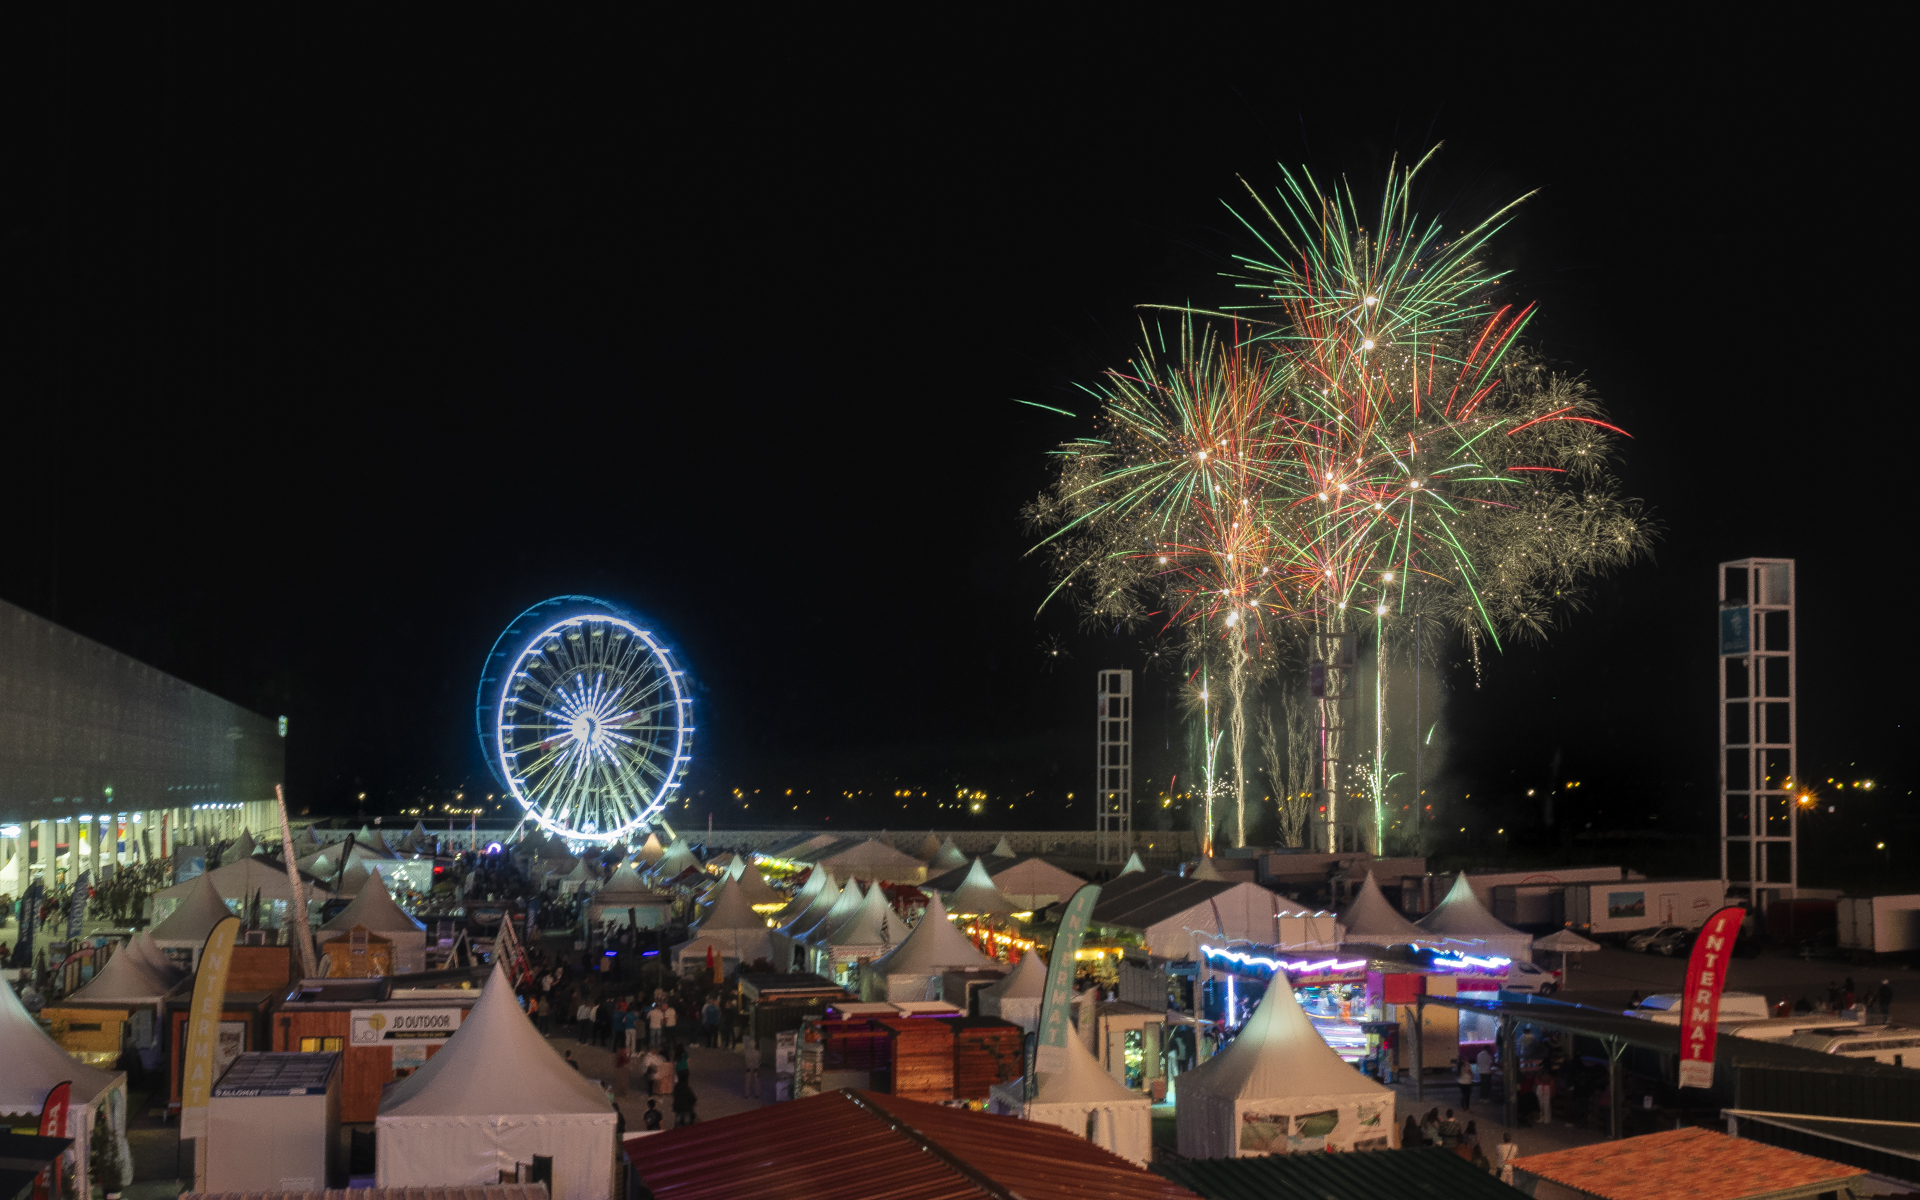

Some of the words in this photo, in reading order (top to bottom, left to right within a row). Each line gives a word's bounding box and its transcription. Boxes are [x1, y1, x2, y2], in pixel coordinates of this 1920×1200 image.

[192, 932, 224, 1104] INTERMAT
[392, 1015, 404, 1028] JD
[405, 1014, 450, 1028] OUTDOOR
[1049, 897, 1085, 1043] INTERMAT
[1690, 918, 1725, 1059] INTERMAT
